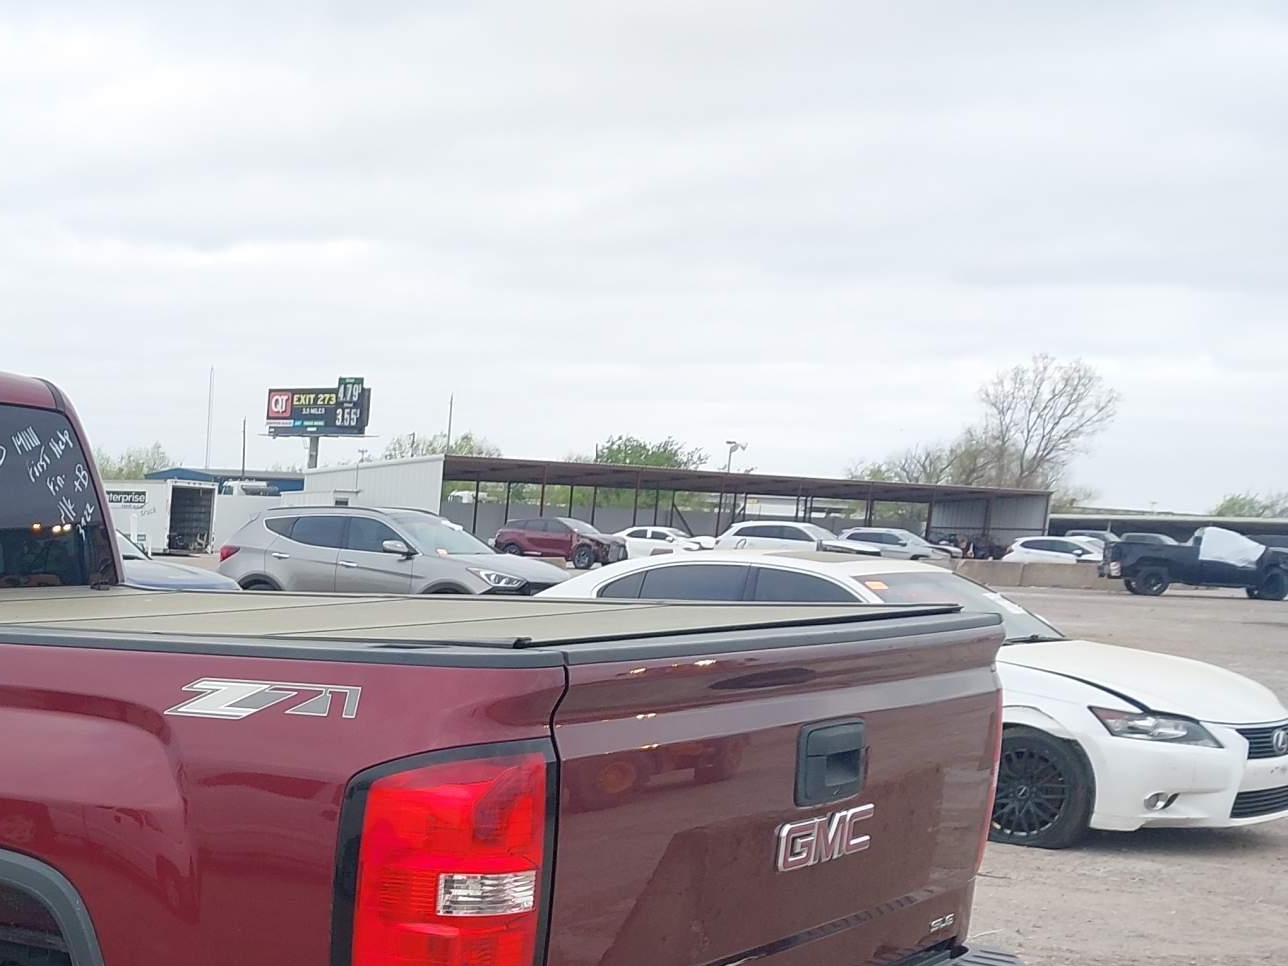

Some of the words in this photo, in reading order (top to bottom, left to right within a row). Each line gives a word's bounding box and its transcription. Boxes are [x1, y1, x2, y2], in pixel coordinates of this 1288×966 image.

[271, 394, 288, 413] QT
[293, 393, 315, 405] EXIT
[317, 393, 336, 405] 273
[777, 803, 874, 872] GMC
